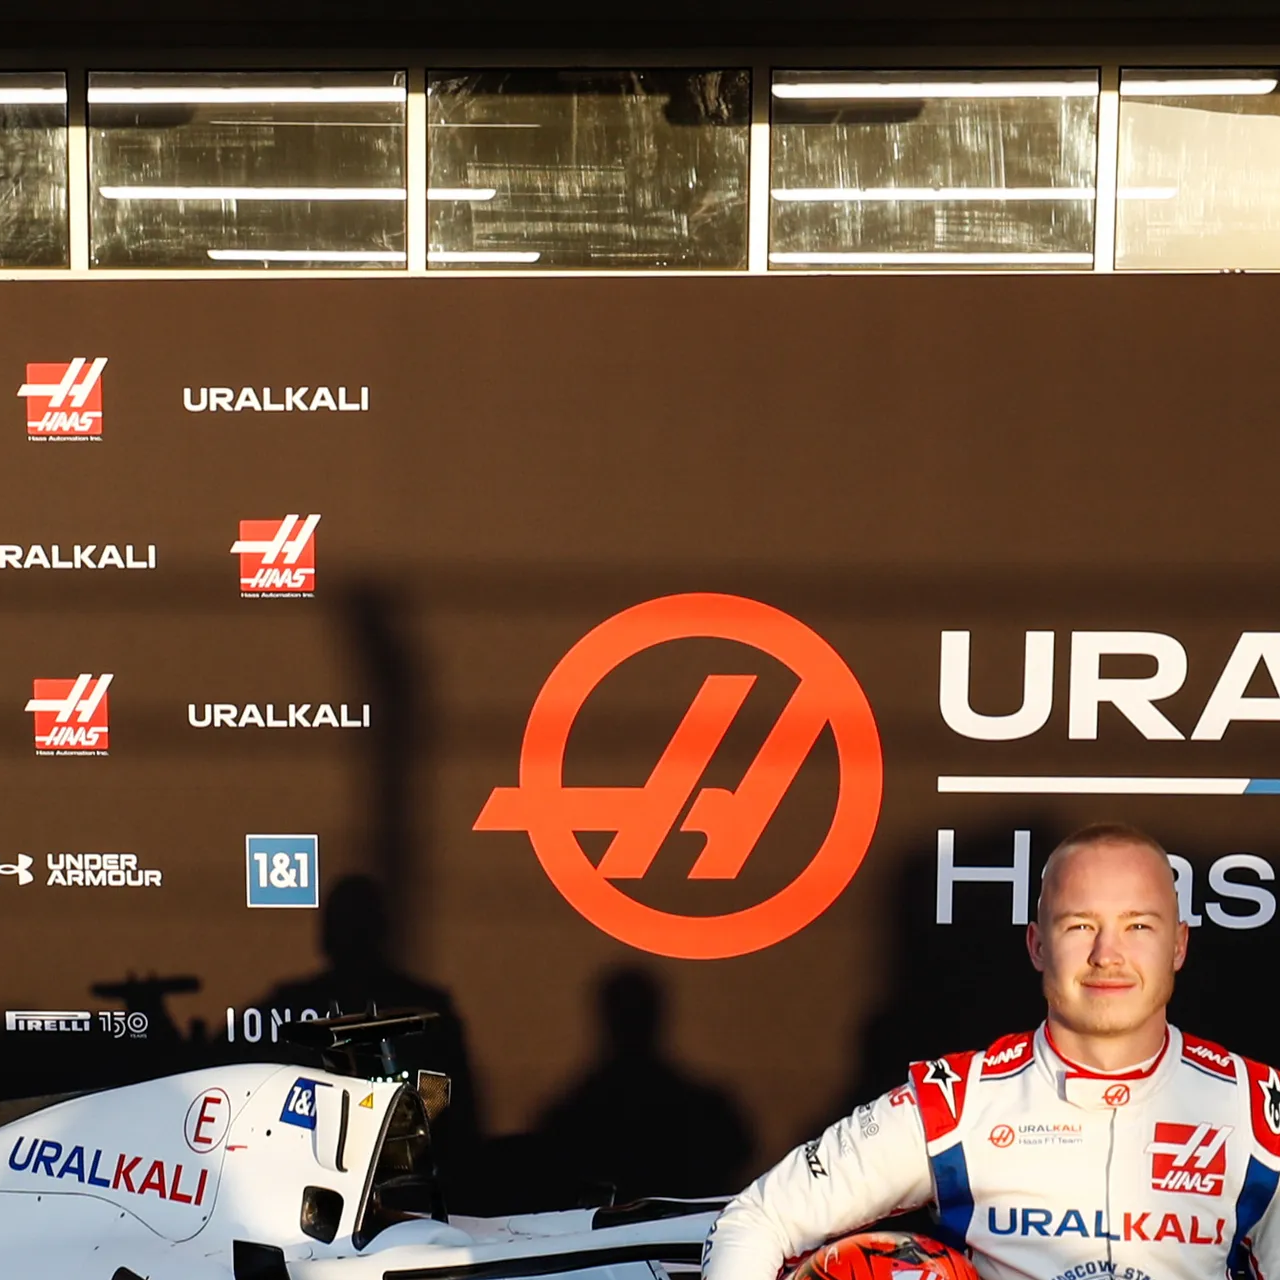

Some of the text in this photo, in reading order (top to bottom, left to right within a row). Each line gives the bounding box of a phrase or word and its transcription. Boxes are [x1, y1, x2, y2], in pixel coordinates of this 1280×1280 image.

[184, 387, 369, 411] URALKALI
[27, 411, 102, 431] HAAS
[241, 568, 314, 588] HAAS
[188, 704, 370, 728] URALKALI
[35, 726, 109, 746] HAAS
[47, 853, 138, 869] UNDER
[254, 852, 309, 889] 1&1
[47, 869, 162, 887] ARMOUR
[935, 829, 1277, 930] Has
[5, 1011, 91, 1031] PIRELLI
[193, 1096, 222, 1145] E
[1019, 1124, 1082, 1133] URALKALI
[9, 1135, 209, 1206] URALKALI
[1151, 1171, 1225, 1192] HAAS
[988, 1207, 1226, 1245] URALKALI
